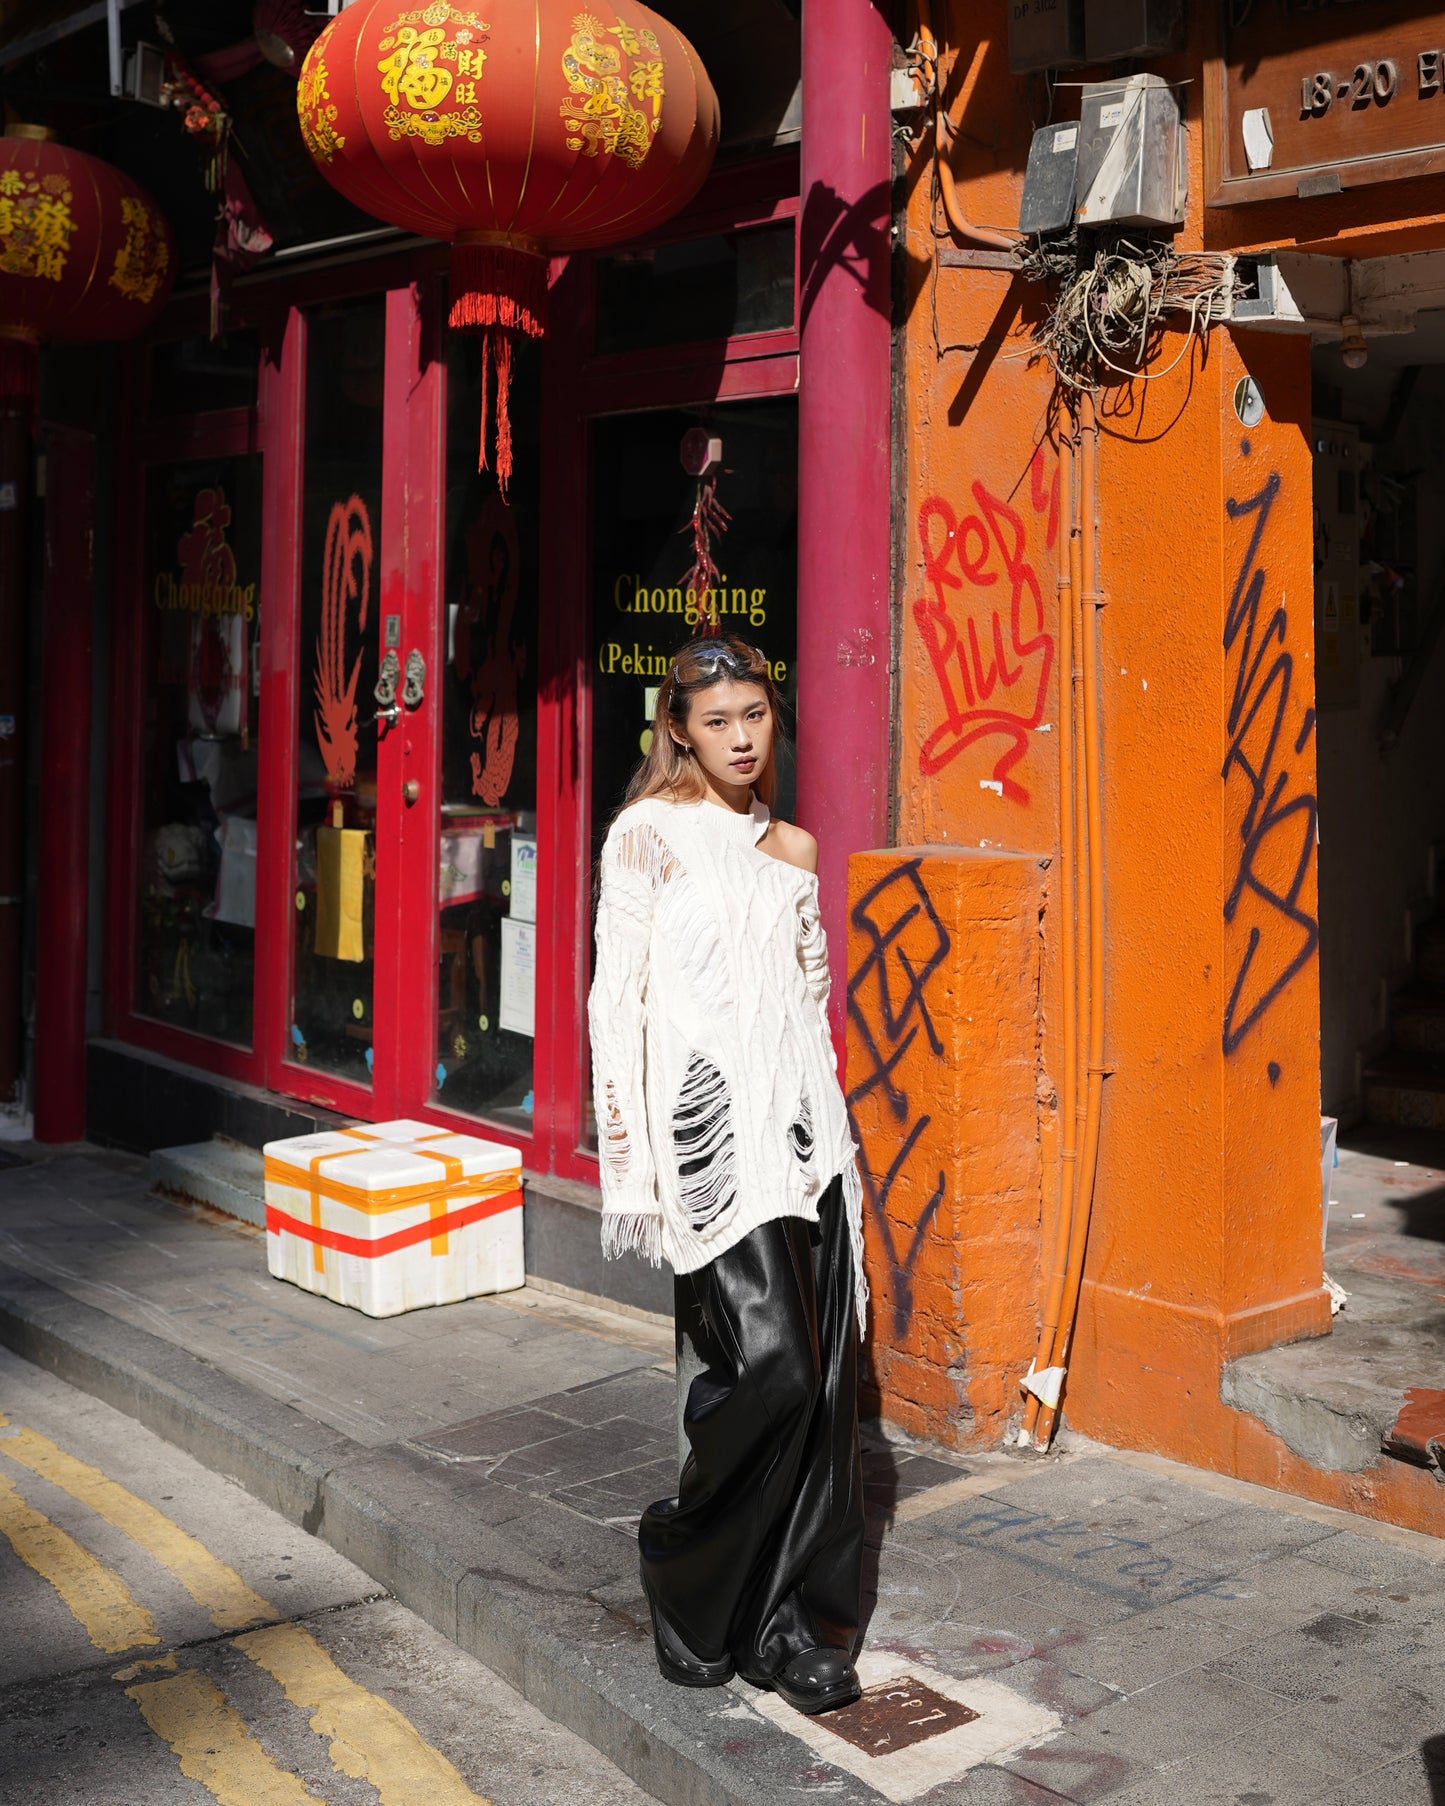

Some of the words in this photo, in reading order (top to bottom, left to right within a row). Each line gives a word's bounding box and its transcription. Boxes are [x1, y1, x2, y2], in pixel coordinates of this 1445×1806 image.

[377, 26, 453, 110] 福
[1300, 60, 1397, 110] 18-20
[1417, 50, 1445, 89] E
[614, 574, 767, 627] Chongqing
